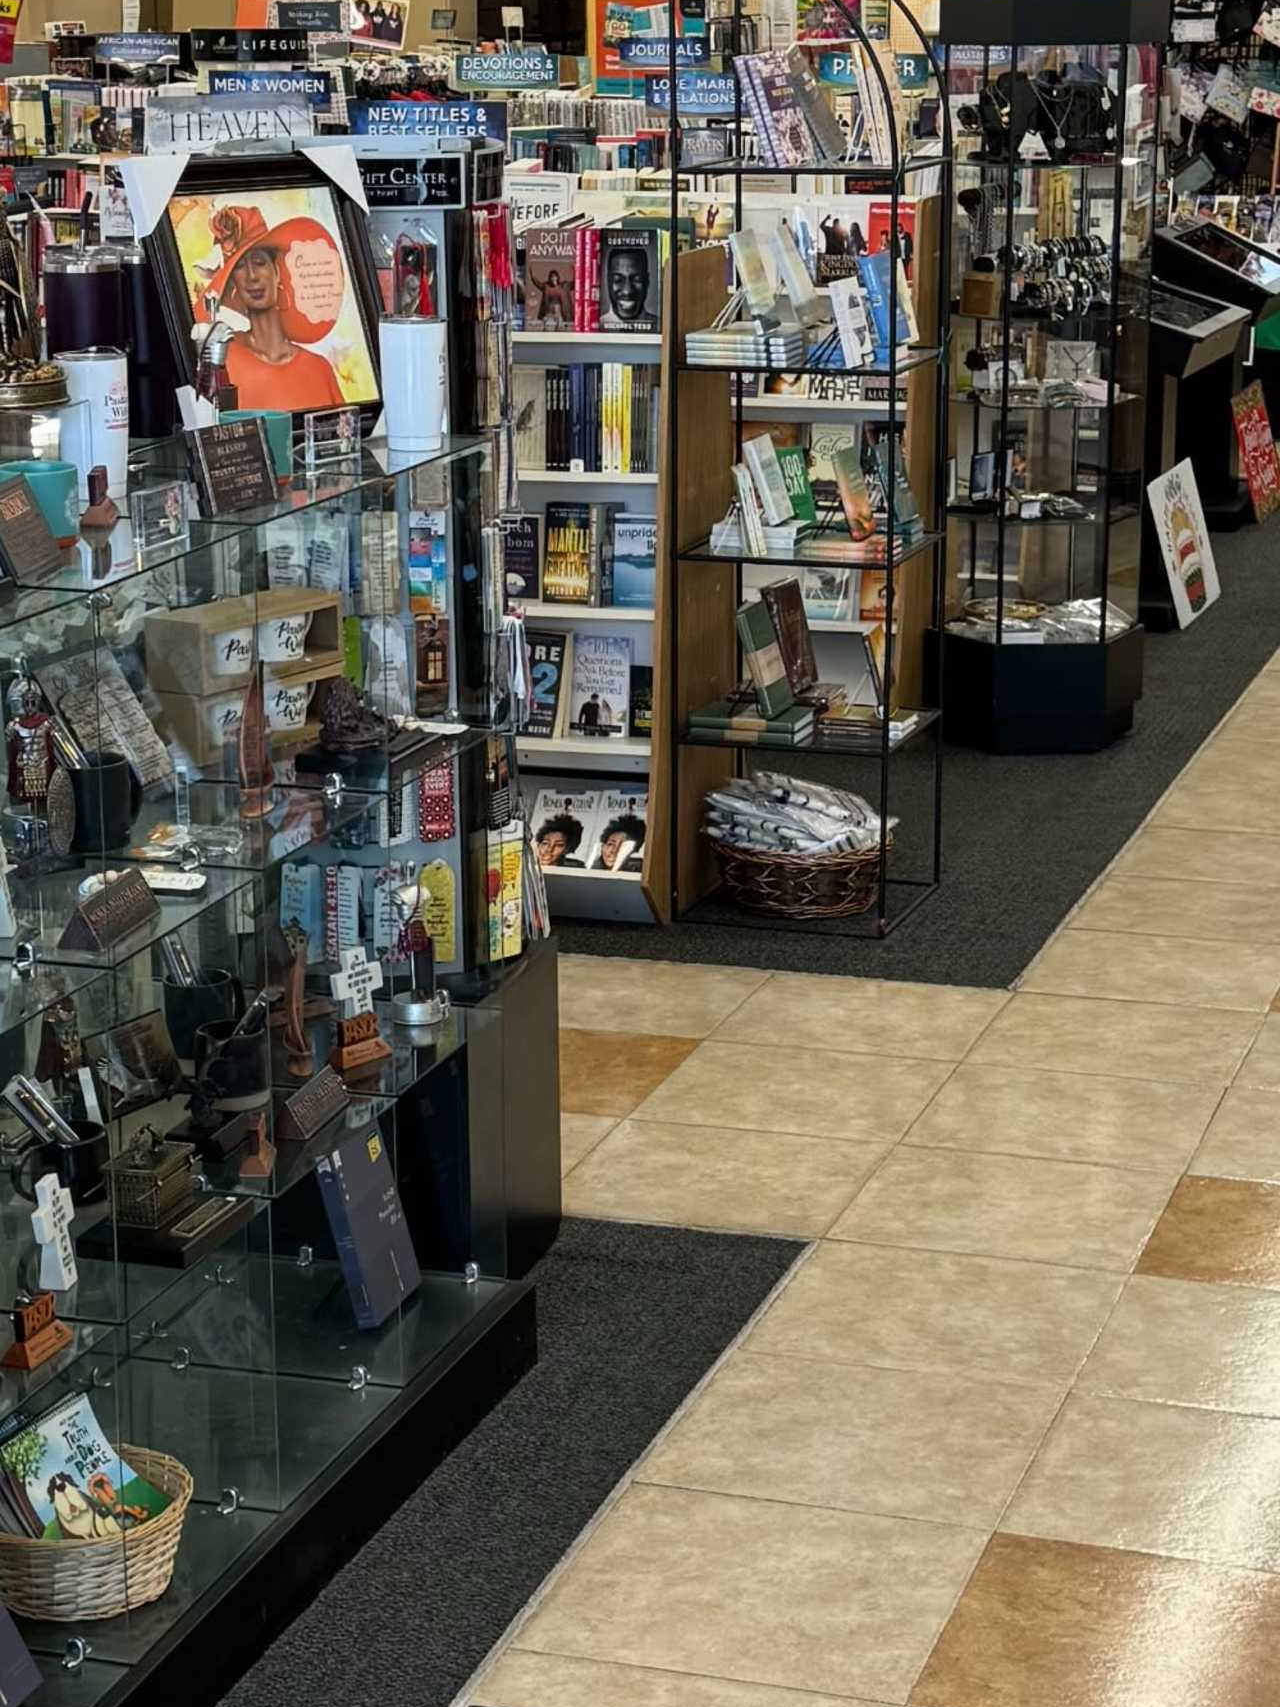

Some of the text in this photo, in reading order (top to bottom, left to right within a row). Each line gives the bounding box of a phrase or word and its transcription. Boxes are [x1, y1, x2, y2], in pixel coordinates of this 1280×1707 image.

[462, 57, 553, 70] DEVOTIONS &
[462, 70, 554, 80] ENCOURAGEMENT
[214, 77, 325, 93] MEN & WOMEN
[368, 108, 487, 122] NEW TITLES &
[171, 111, 292, 141] HEAVEN
[540, 232, 557, 243] DO
[532, 662, 558, 704] 2
[327, 903, 339, 964] ISAIAH
